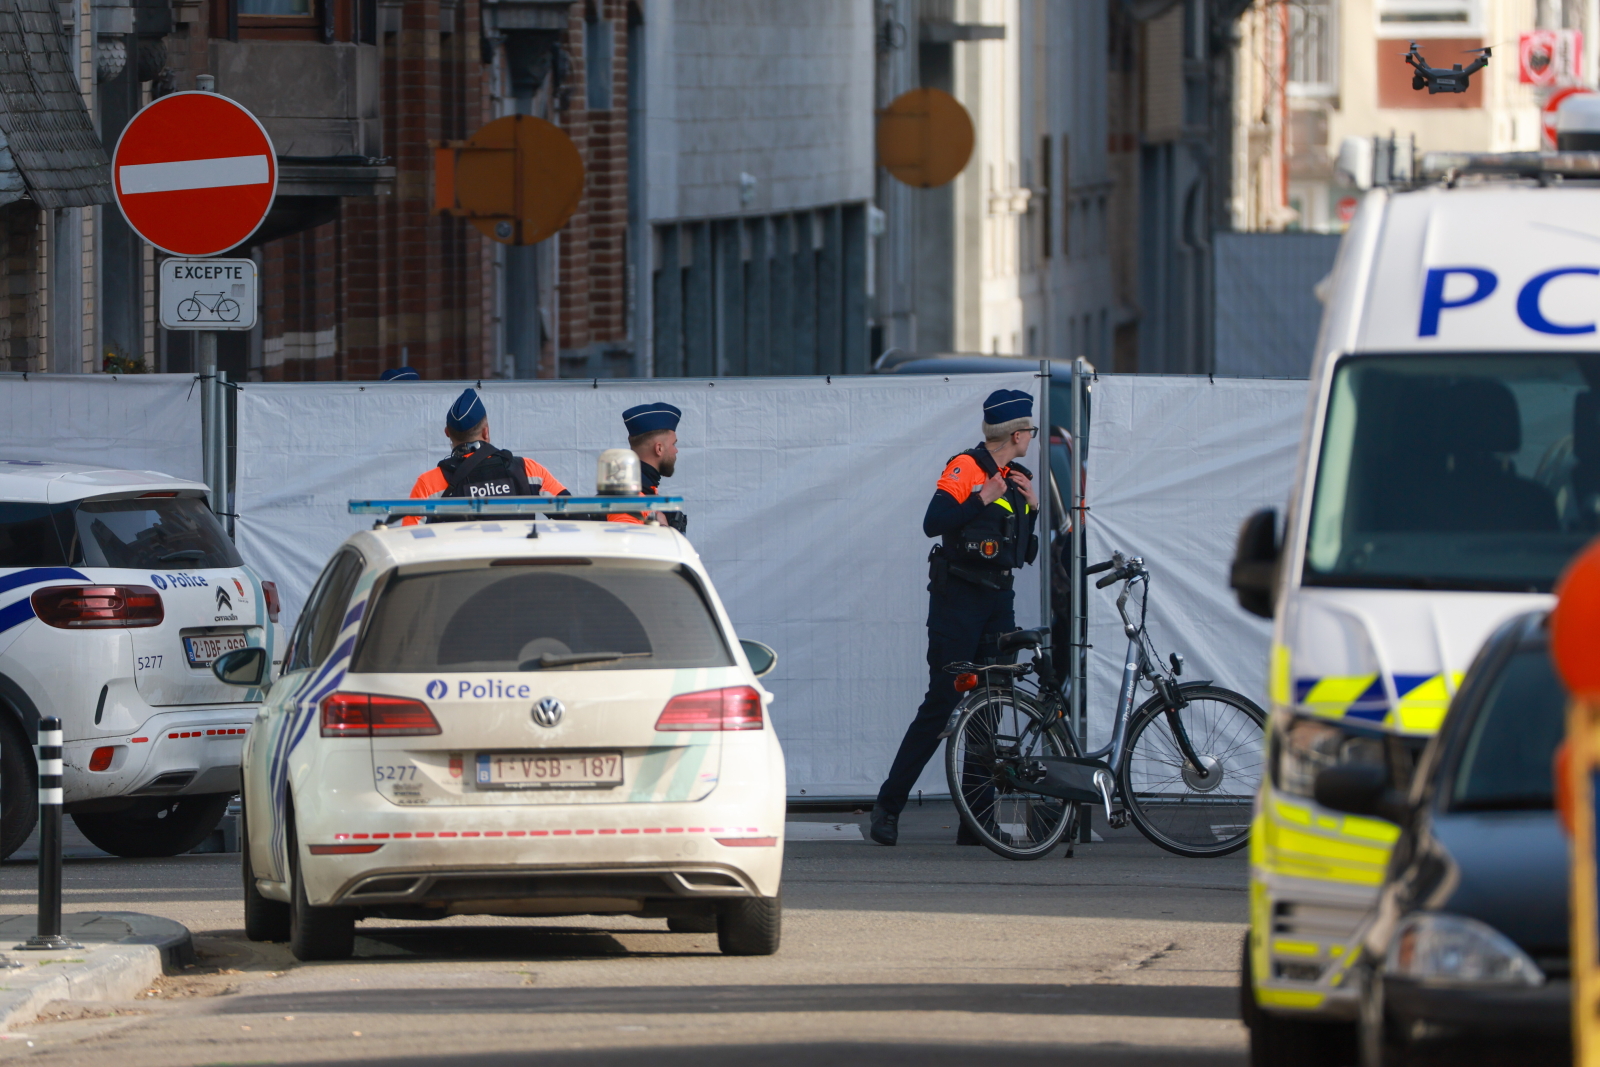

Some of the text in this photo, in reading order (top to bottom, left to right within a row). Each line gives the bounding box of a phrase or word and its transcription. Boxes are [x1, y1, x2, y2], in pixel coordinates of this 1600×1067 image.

[174, 266, 243, 279] EXCEPTE
[469, 482, 511, 498] Police
[165, 572, 209, 588] Police
[138, 655, 163, 671] 5277
[458, 679, 531, 698] Police
[375, 765, 418, 781] 5277
